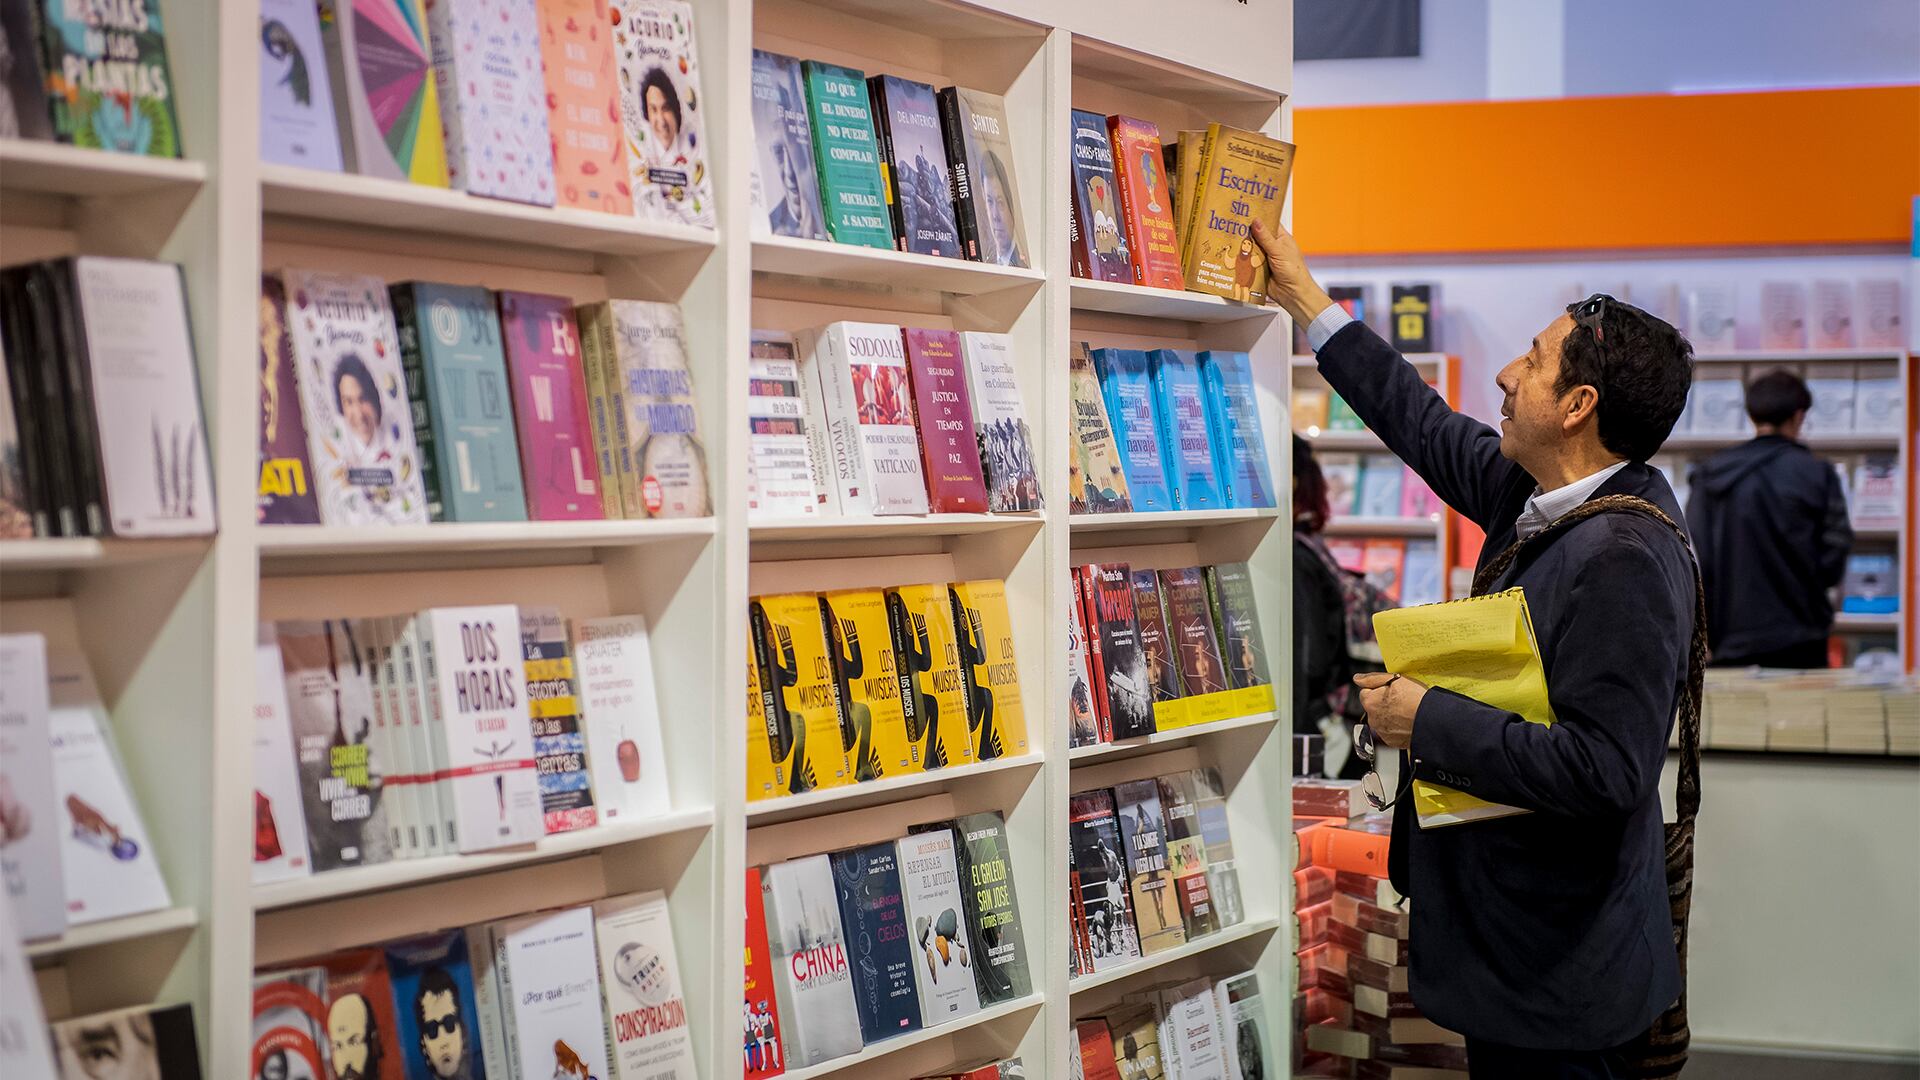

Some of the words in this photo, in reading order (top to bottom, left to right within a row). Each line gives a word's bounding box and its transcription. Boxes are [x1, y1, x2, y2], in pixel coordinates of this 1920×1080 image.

[62, 55, 168, 100] PLANTAS
[826, 80, 838, 94] LO
[839, 83, 856, 98] QUE
[821, 102, 834, 116] EL
[835, 105, 867, 121] DINERO
[828, 125, 843, 139] NO
[844, 128, 869, 142] PUEDE
[972, 113, 1000, 136] SANTOS
[830, 147, 874, 165] COMPRAR
[955, 163, 970, 200] SANTOS
[1218, 167, 1278, 201] Escrivir
[839, 194, 880, 208] MICHAEL
[1230, 195, 1250, 217] sin
[852, 216, 885, 230] SANDEL
[917, 230, 935, 241] JOSEPH
[849, 337, 903, 362] SODOMA
[629, 368, 691, 397] HISTORIAS
[927, 366, 955, 378] SEGURIDAD
[931, 391, 959, 405] JUSTICIA
[1135, 396, 1150, 419] filo
[936, 419, 964, 432] TIEMPOS
[1127, 434, 1156, 458] navaja
[1180, 432, 1209, 456] navaja
[874, 457, 917, 476] VATICANO
[948, 453, 963, 465] PAZ
[459, 621, 498, 664] DOS
[580, 622, 634, 641] FERNANDO
[878, 648, 894, 674] LOS
[1000, 638, 1014, 661] LOS
[812, 656, 828, 681] LOS
[987, 659, 1018, 683] MUISCAS
[454, 668, 516, 715] HORAS
[863, 676, 899, 705] MUISCAS
[900, 674, 910, 692] LOS
[931, 668, 960, 695] MUISCAS
[798, 682, 832, 711] MUISCAS
[902, 691, 914, 719] MUISCAS
[765, 706, 779, 738] MUISCAS
[331, 793, 371, 822] CORRER
[869, 858, 881, 867] Juan
[906, 856, 943, 876] REPENSAR
[970, 862, 981, 887] EL
[980, 856, 1006, 882] GALEÓN
[933, 869, 957, 887] MUNDO
[976, 887, 994, 912] SAN
[993, 879, 1011, 909] JOSÉ
[877, 923, 906, 944] CIELOS
[632, 954, 660, 985] TRUMP
[791, 943, 847, 983] CHINA
[614, 993, 686, 1044] CONSPIRACIÓN
[1135, 1055, 1156, 1072] AMOR
